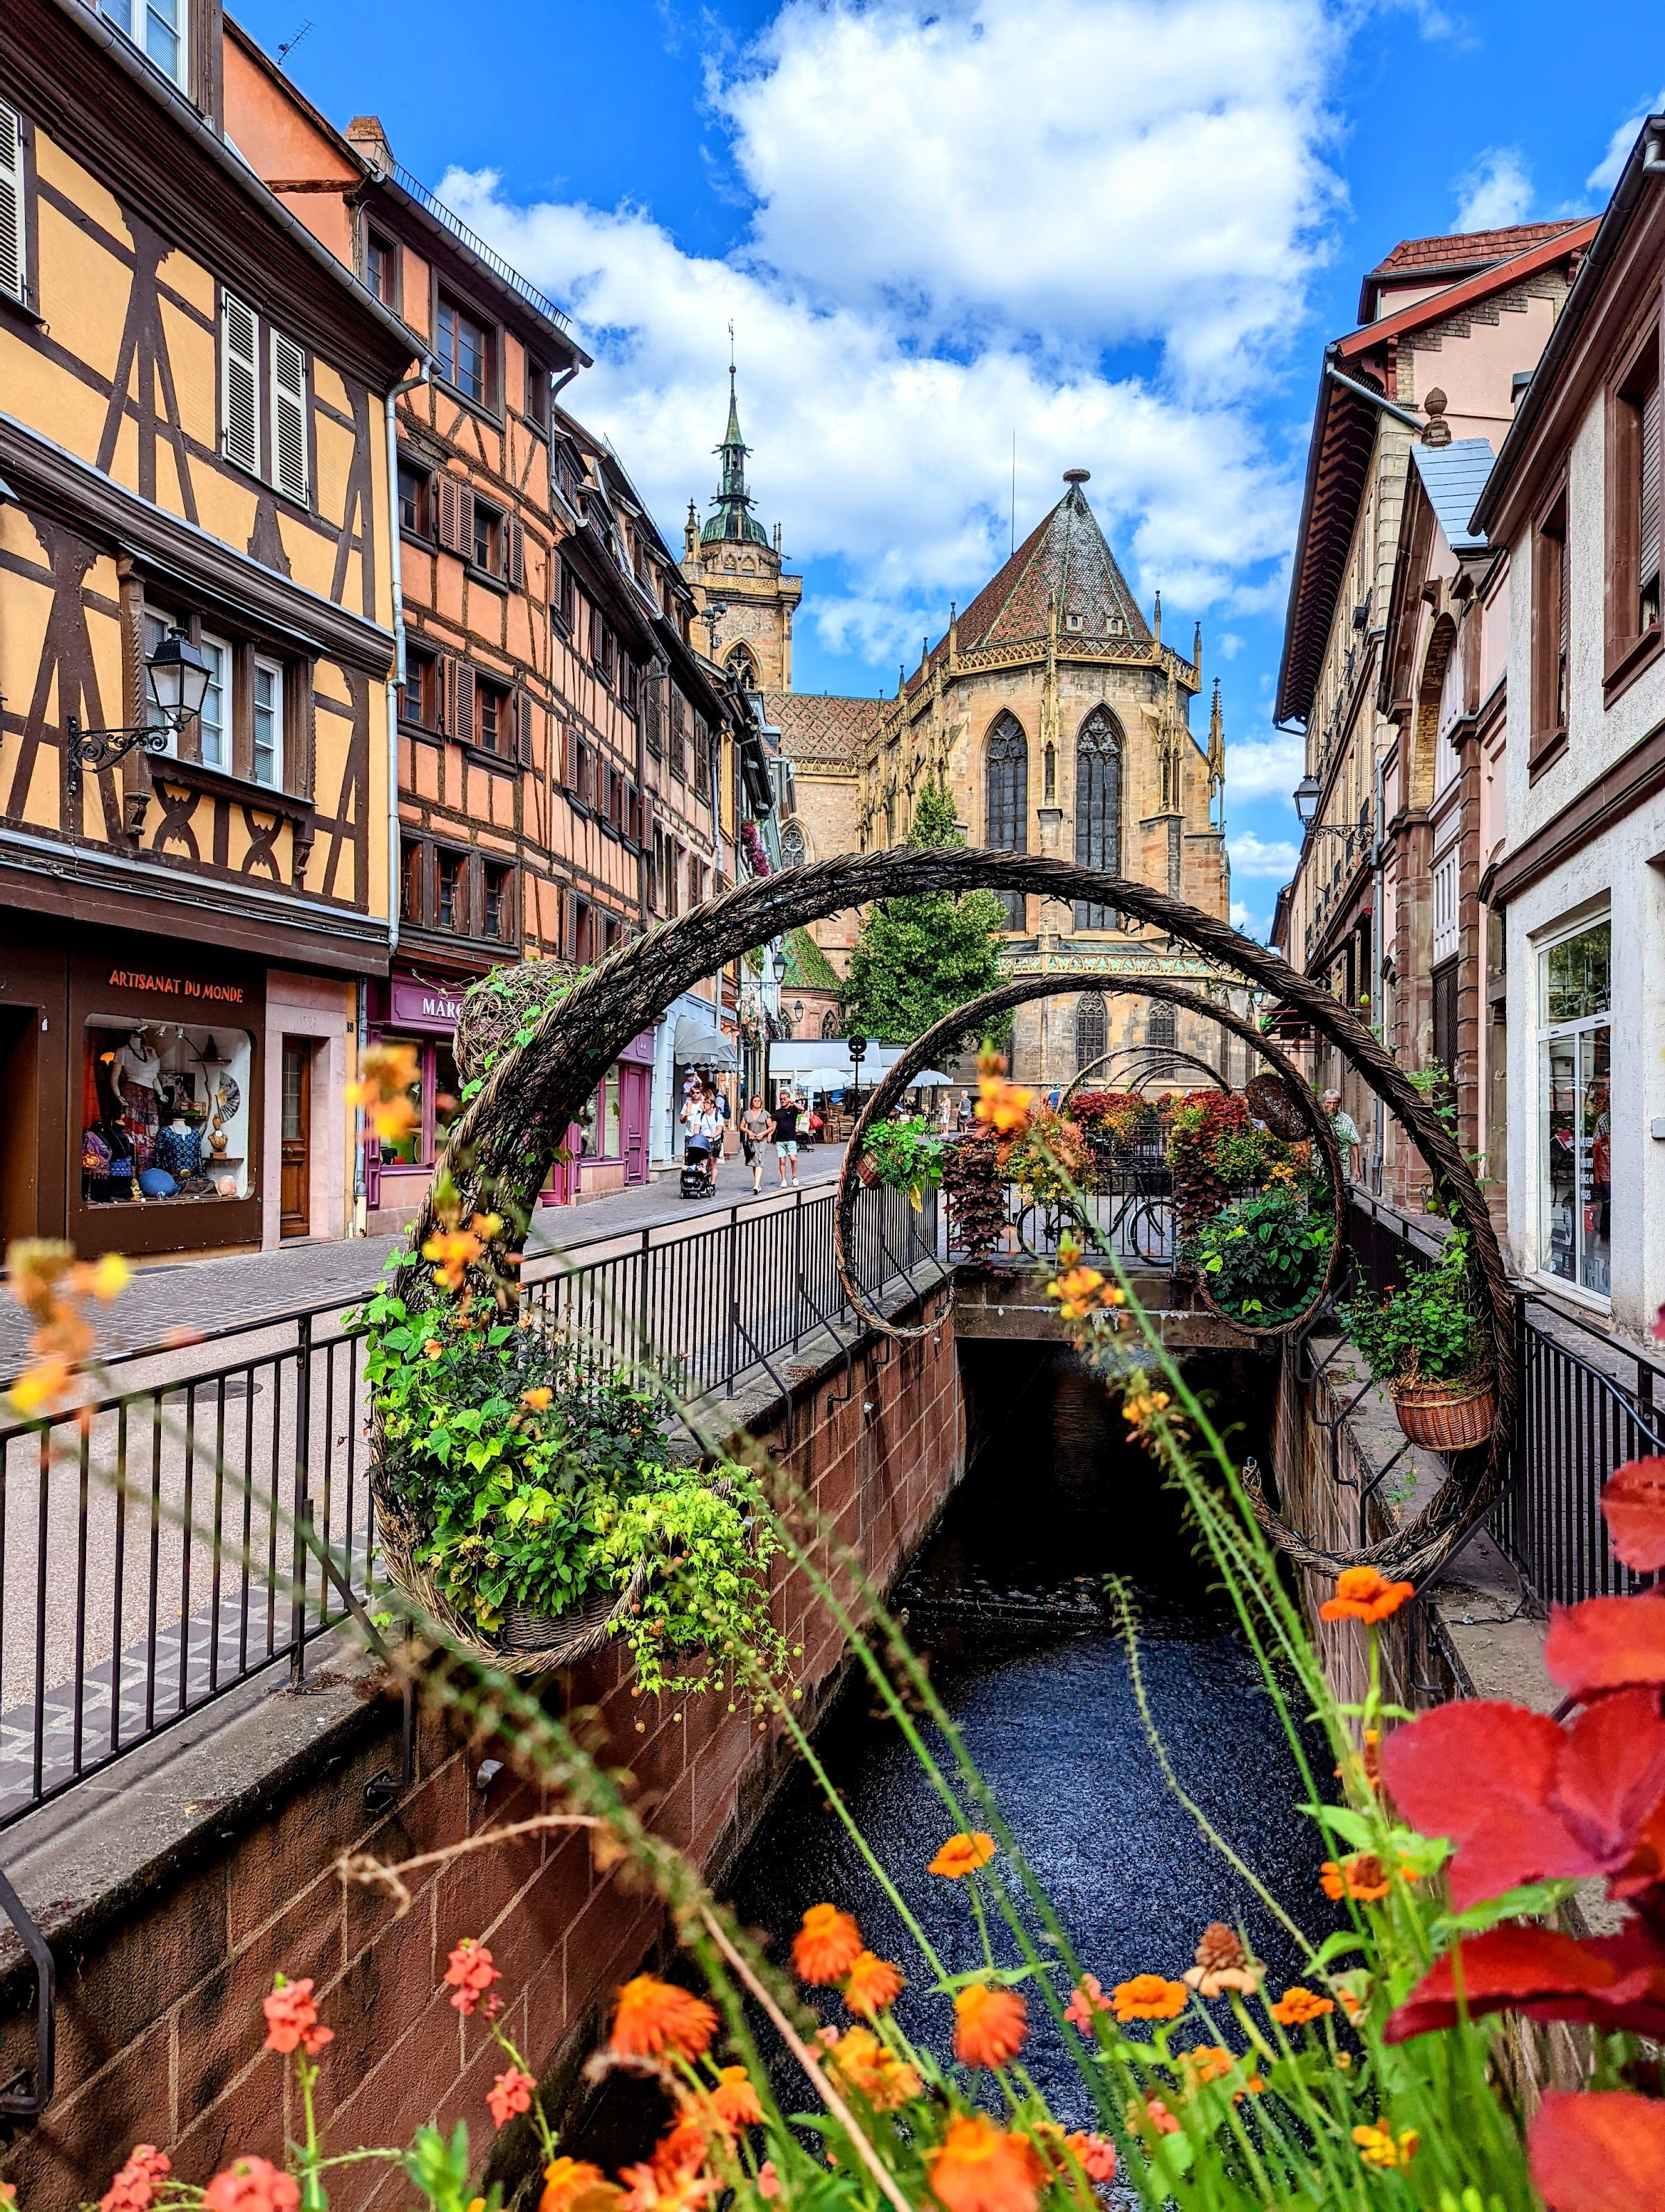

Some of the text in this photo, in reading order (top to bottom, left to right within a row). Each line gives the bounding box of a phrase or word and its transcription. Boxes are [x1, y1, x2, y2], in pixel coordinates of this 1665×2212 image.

[109, 970, 243, 1003] ARTISANAT DU MONDE
[299, 1016, 317, 1028] 1592
